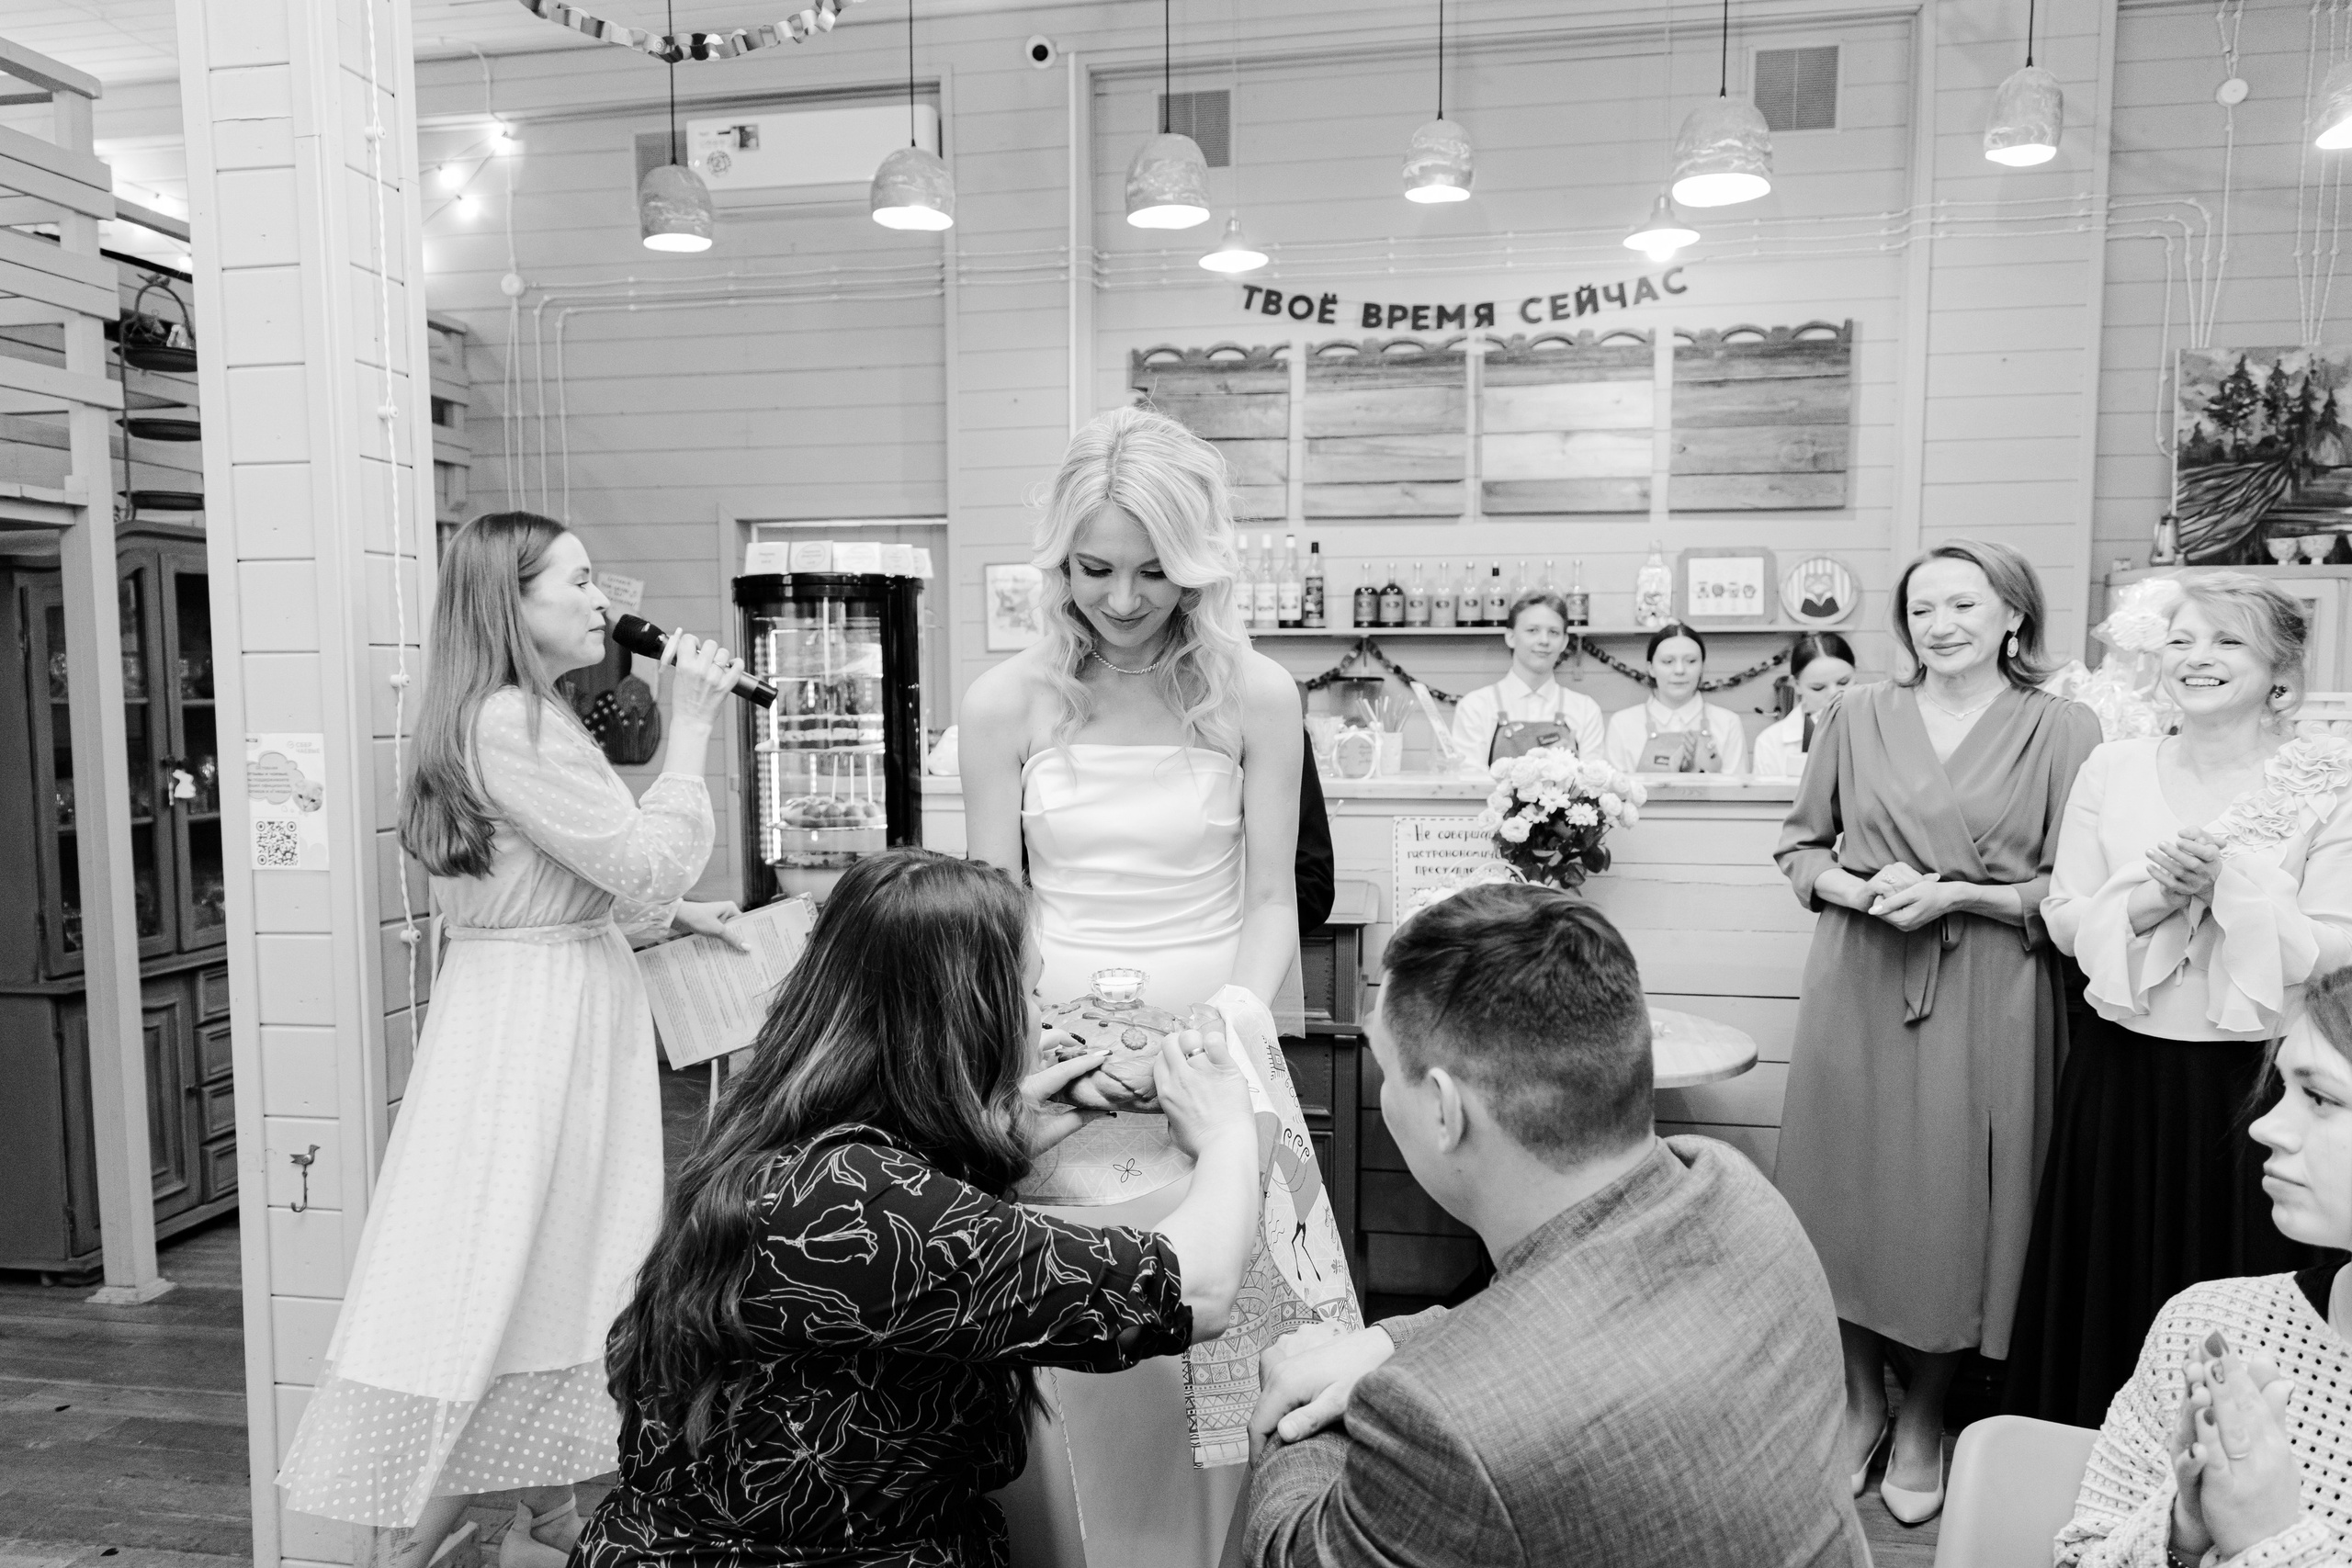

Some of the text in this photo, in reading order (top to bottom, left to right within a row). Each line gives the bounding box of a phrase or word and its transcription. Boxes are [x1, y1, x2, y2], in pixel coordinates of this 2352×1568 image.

[1242, 266, 1688, 331] ТВОЁ ВРЕМЯ СЕЙЧАС
[1415, 823, 1430, 841] Не
